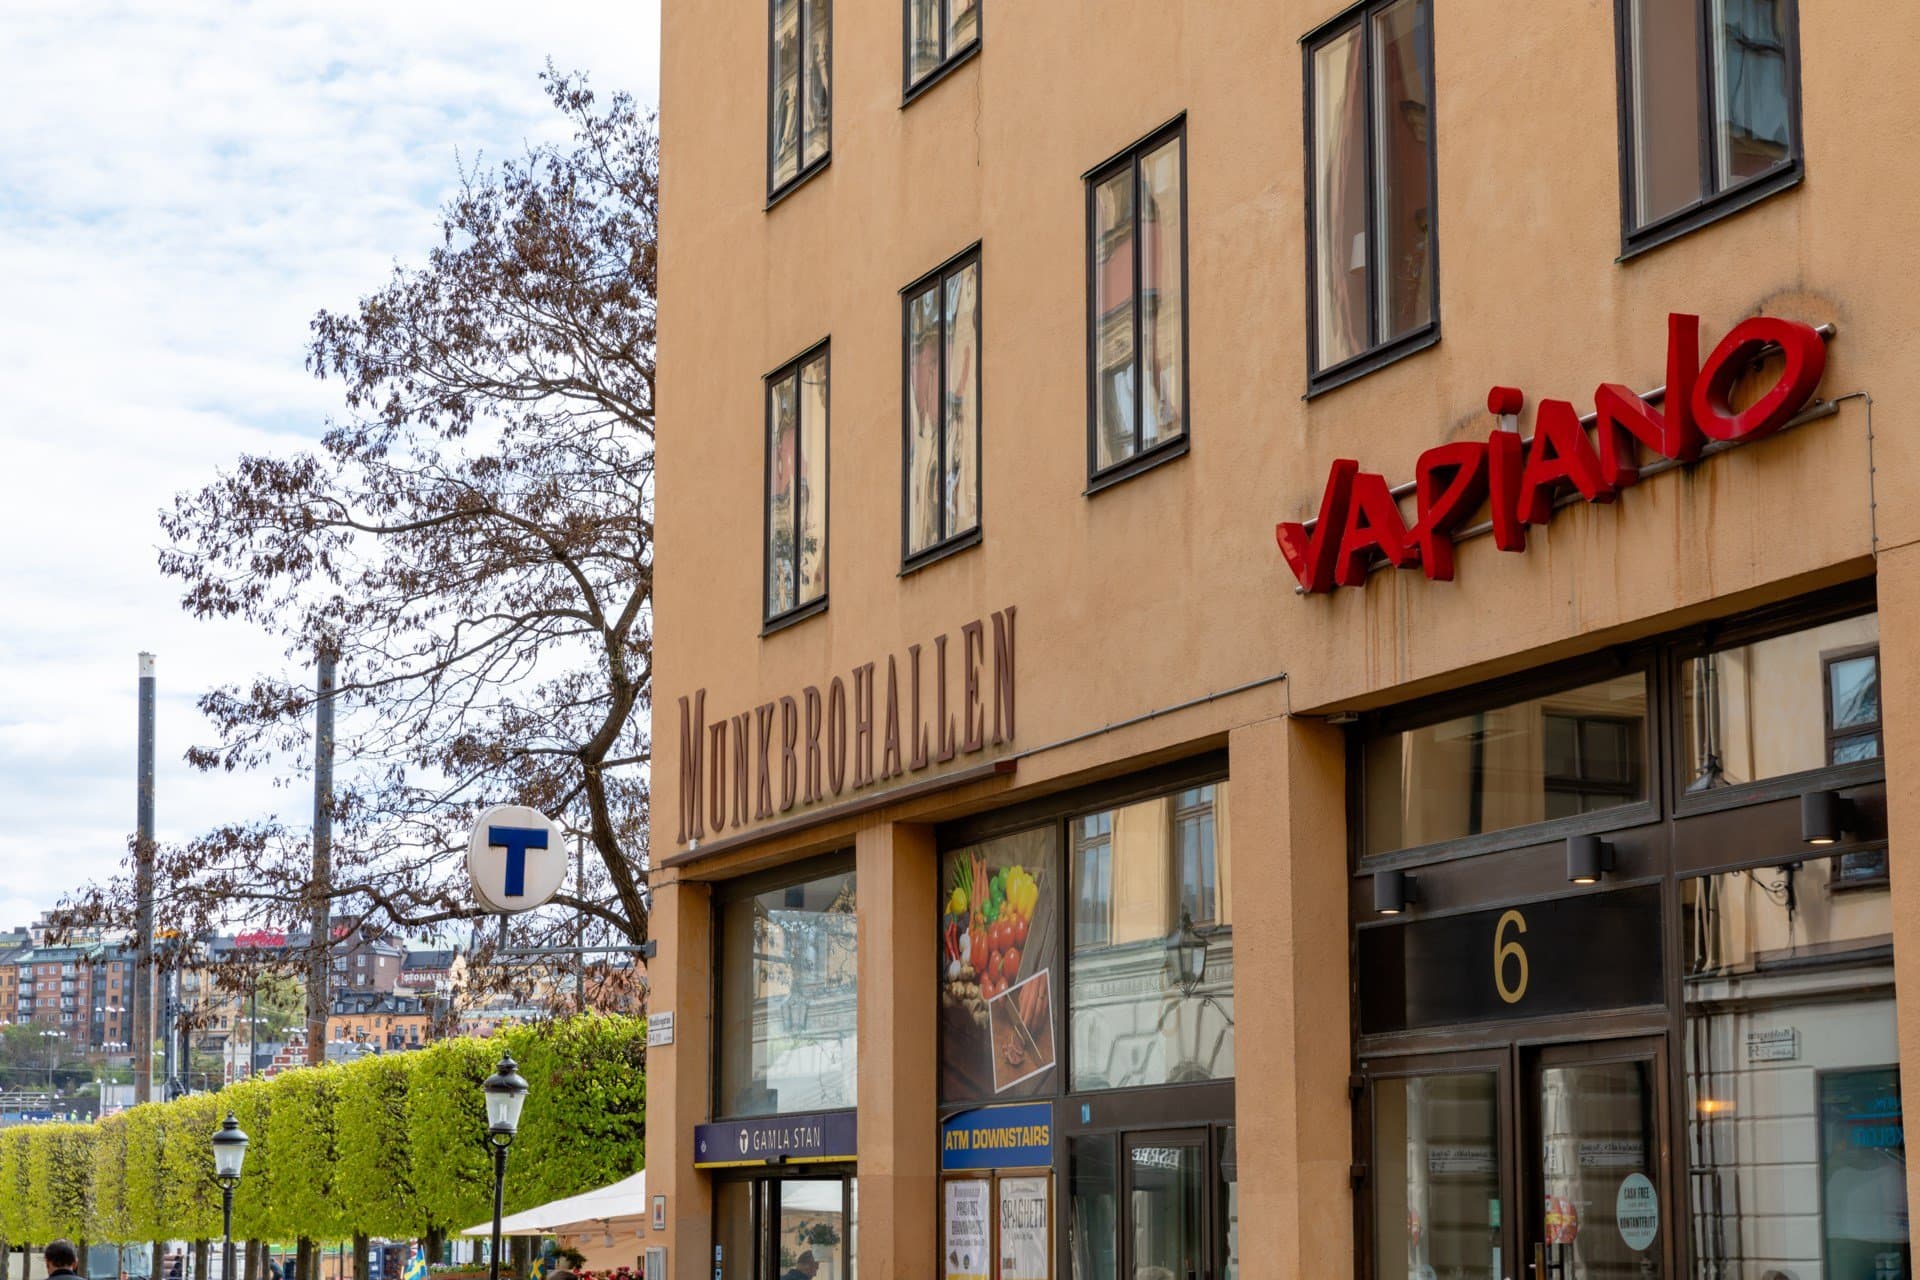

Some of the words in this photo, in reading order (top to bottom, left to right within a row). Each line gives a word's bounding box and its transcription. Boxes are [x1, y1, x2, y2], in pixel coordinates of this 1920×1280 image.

[488, 825, 549, 897] T
[1494, 909, 1528, 1004] 6
[753, 1128, 790, 1151] GAMLA
[793, 1126, 820, 1149] STAN
[945, 1129, 969, 1151] ATM
[972, 1125, 1049, 1149] DOWNSTAIRS
[1637, 1186, 1650, 1199] FREE
[1002, 1199, 1046, 1230] SPAGHETTI
